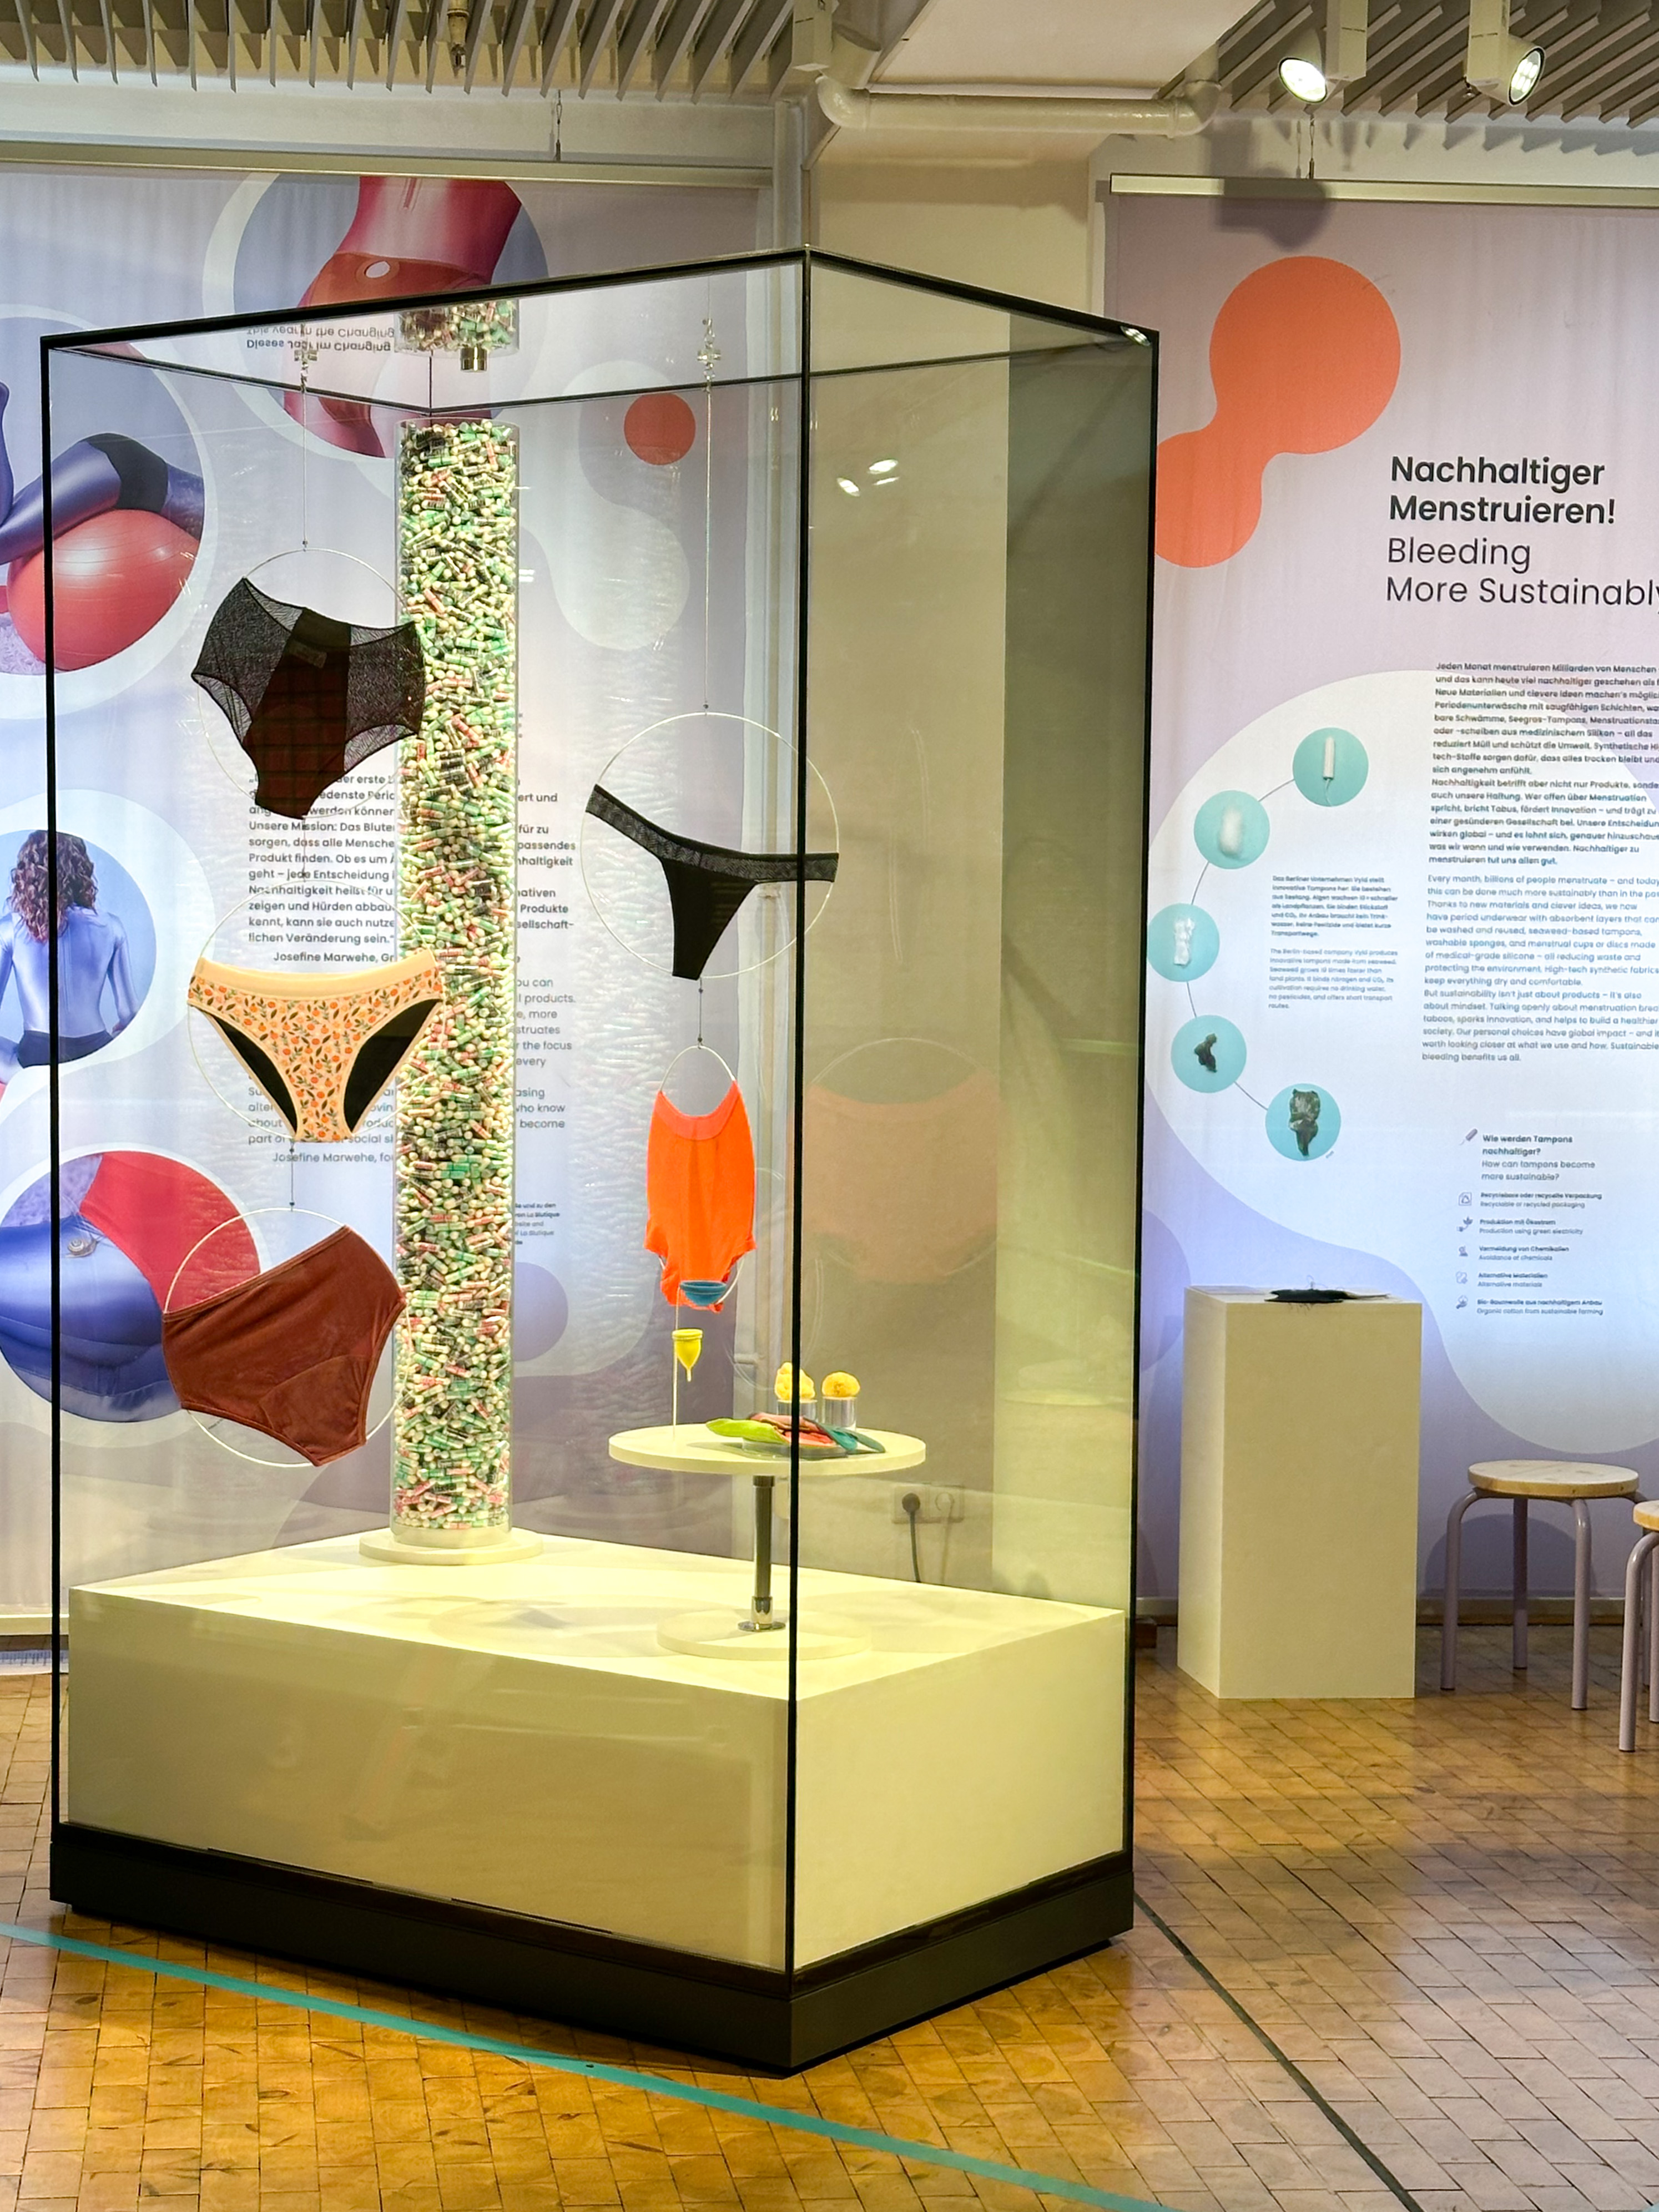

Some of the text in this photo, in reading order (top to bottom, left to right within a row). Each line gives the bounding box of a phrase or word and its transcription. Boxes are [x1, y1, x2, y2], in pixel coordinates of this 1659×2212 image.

[1391, 456, 1605, 493] Nachhaltiger
[1390, 495, 1615, 524] Menstruieren!
[1388, 537, 1530, 574] Bleeding
[1387, 577, 1467, 602] More
[1436, 662, 1463, 670] Jeden
[1492, 663, 1551, 671] menstruieren
[1552, 664, 1594, 672] Milliarden
[1519, 728, 1585, 736] medizinischem
[1586, 729, 1615, 738] Silikon
[1624, 729, 1635, 738] all
[1636, 729, 1652, 738] das
[1451, 766, 1498, 776] angenehm
[536, 793, 558, 802] und
[1486, 792, 1522, 802] Haltung.
[1567, 792, 1587, 801] über
[249, 821, 288, 830] Unsere
[340, 822, 361, 831] Das
[518, 825, 534, 834] für
[249, 837, 342, 849] sorgen, dass alle
[518, 841, 576, 851] passendes
[249, 852, 292, 862] Produkt
[295, 854, 332, 863] finden.
[335, 854, 351, 863] Ob
[1540, 857, 1557, 867] gut.
[248, 868, 390, 882] geht jede Entscheidung
[1428, 874, 1450, 885] Every
[1452, 875, 1482, 883] month,
[1526, 876, 1556, 885] people
[248, 900, 353, 913] zeigen und Hürden
[520, 904, 569, 913] Produkte
[1428, 900, 1457, 908] Thanks
[1578, 902, 1603, 910] ideas,
[249, 916, 363, 927] kennt, kann sie auch
[249, 932, 283, 942] lichen
[286, 933, 361, 945] Veränderung
[274, 951, 379, 963] Josefine Marwehe,
[1424, 976, 1445, 986] keep
[1447, 977, 1492, 987] everything
[1494, 978, 1507, 987] dry
[525, 994, 576, 1004] products.
[522, 1041, 572, 1050] the focus
[1421, 1052, 1459, 1063] bleeding
[1461, 1052, 1495, 1061] benefits
[516, 1058, 546, 1068] every
[537, 1104, 566, 1112] know
[520, 1119, 565, 1128] become
[248, 1134, 273, 1145] part
[1534, 1135, 1572, 1145] Tampons
[1482, 1147, 1541, 1157] nachhaltiger?
[322, 1152, 378, 1163] Marwehe,
[1520, 1160, 1558, 1170] tampons
